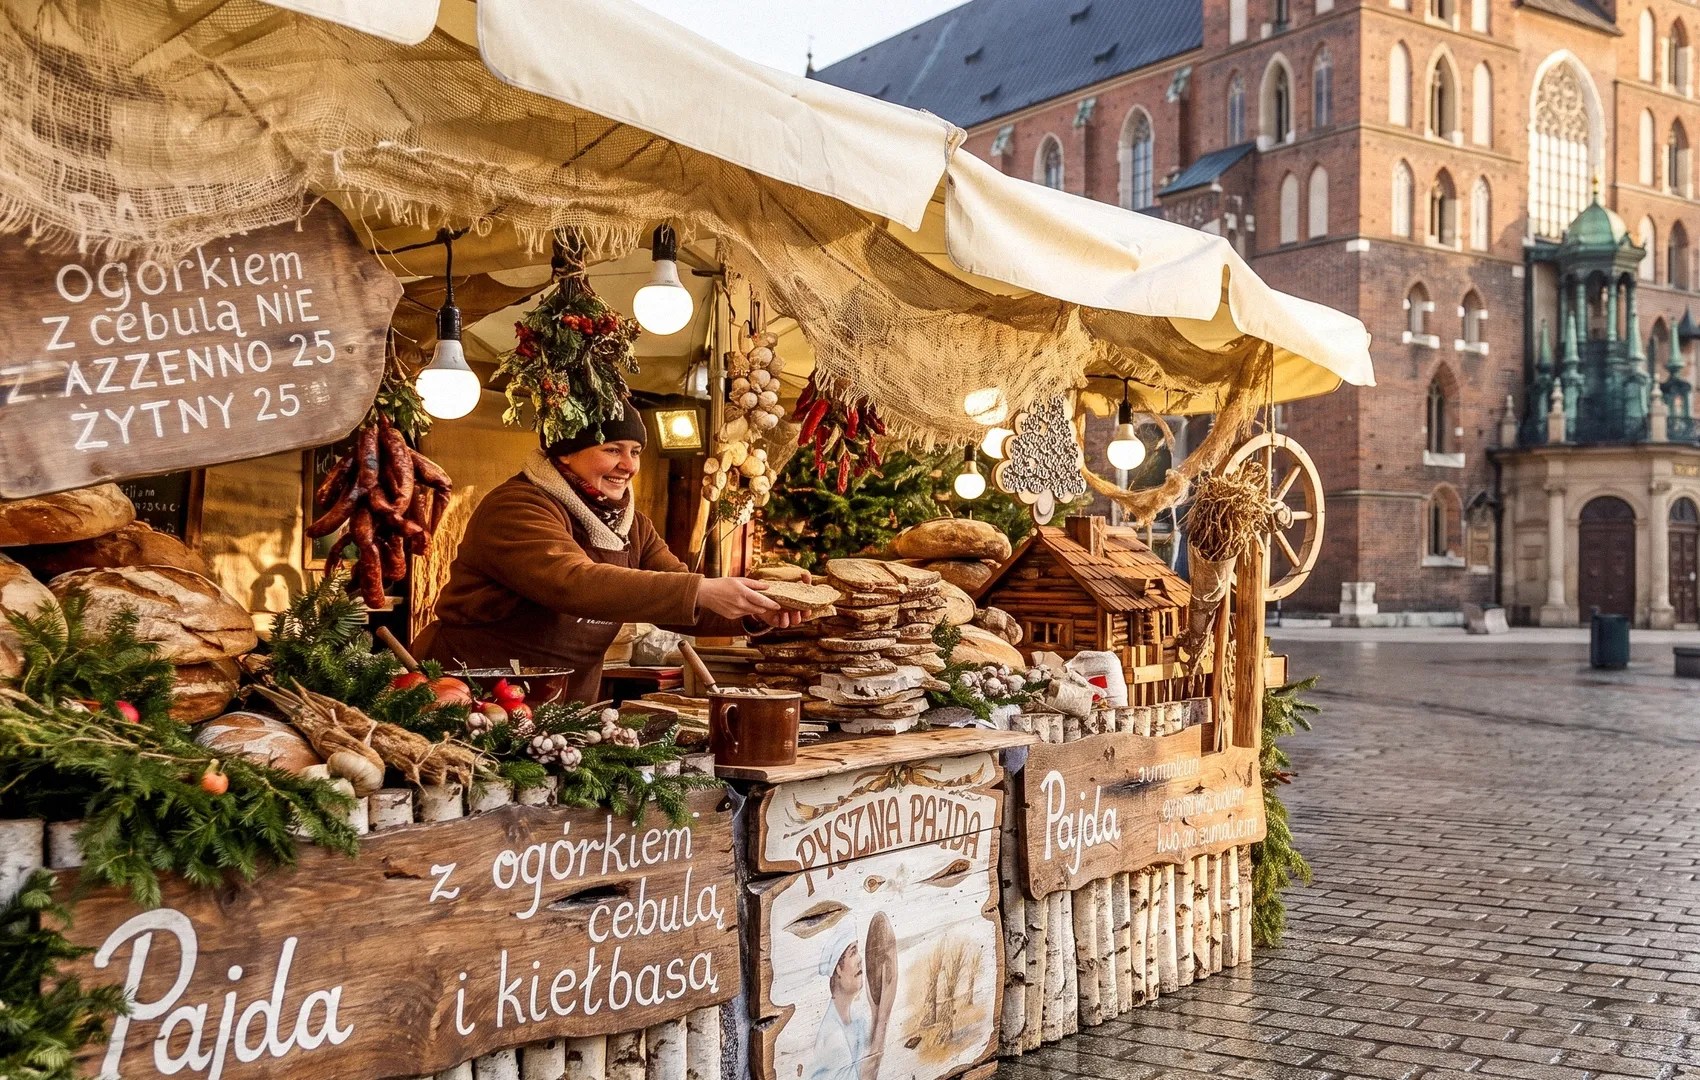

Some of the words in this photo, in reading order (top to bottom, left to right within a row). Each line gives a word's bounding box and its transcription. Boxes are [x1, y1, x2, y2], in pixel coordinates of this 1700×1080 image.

[64, 340, 274, 397] AZZENNO
[289, 330, 336, 367] 25
[89, 297, 247, 346] cebulą
[70, 392, 235, 450] ŻYTNY
[253, 383, 302, 421] 25
[492, 814, 693, 919] ogórkiem
[795, 795, 904, 898] PYSZNA
[908, 793, 982, 860] PAJDA
[1040, 769, 1122, 875] Pajda
[588, 866, 725, 943] cebulą
[93, 907, 355, 1080] Pajda
[455, 971, 476, 1036] i
[496, 946, 720, 1029] kiełbasą
